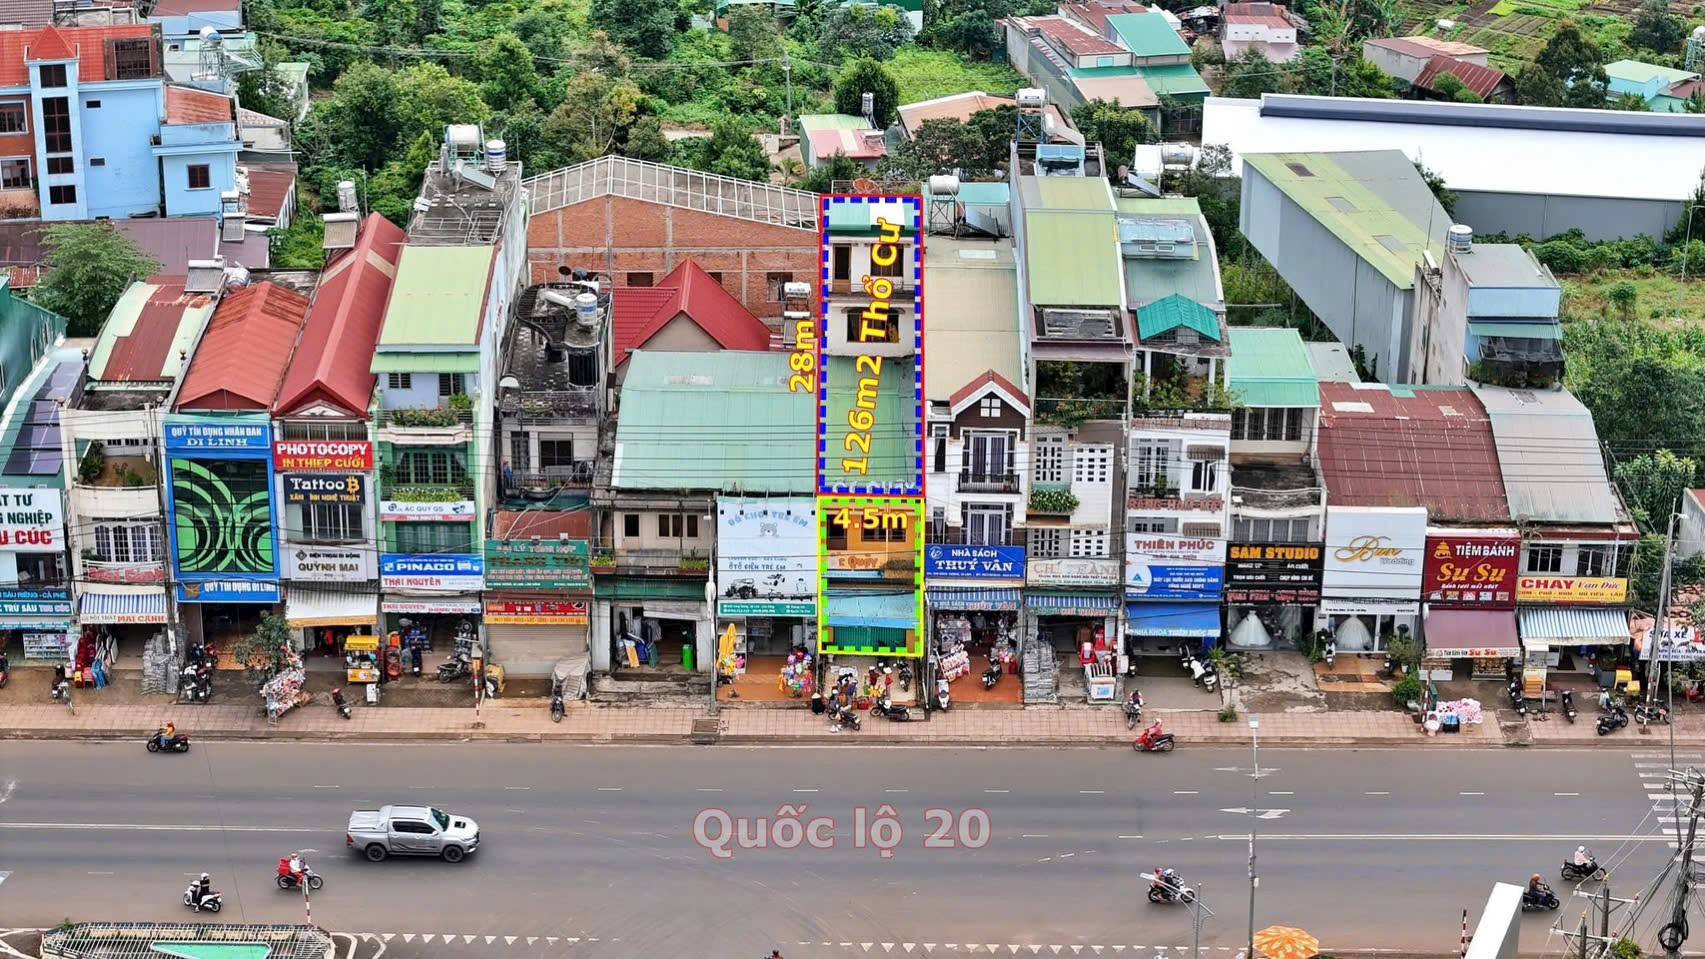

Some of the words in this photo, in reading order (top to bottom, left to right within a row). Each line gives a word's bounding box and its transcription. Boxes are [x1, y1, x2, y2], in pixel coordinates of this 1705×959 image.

[187, 438, 205, 446] DI
[208, 438, 248, 446] LINH
[276, 443, 368, 456] PHOTOCOPY
[282, 458, 294, 468] IN
[335, 455, 365, 468] CƯỚI
[290, 477, 345, 490] Tattoo
[14, 493, 33, 507] TƯ
[7, 509, 53, 527] NGHIỆP
[15, 527, 52, 545] CÚC
[1134, 538, 1175, 549] THIÊN
[1178, 538, 1215, 550] PHÚC
[1455, 541, 1481, 559] TIỆM
[1482, 541, 1515, 556] BÁNH
[951, 548, 971, 557] NHÀ
[972, 548, 997, 557] SÁCH
[1230, 546, 1262, 559] SAM
[1265, 547, 1319, 559] STUDIO
[339, 563, 359, 571] MAI
[396, 563, 455, 571] PINACO
[1436, 562, 1470, 581] Su
[1473, 563, 1507, 581] Su
[1521, 580, 1576, 589] CHAY
